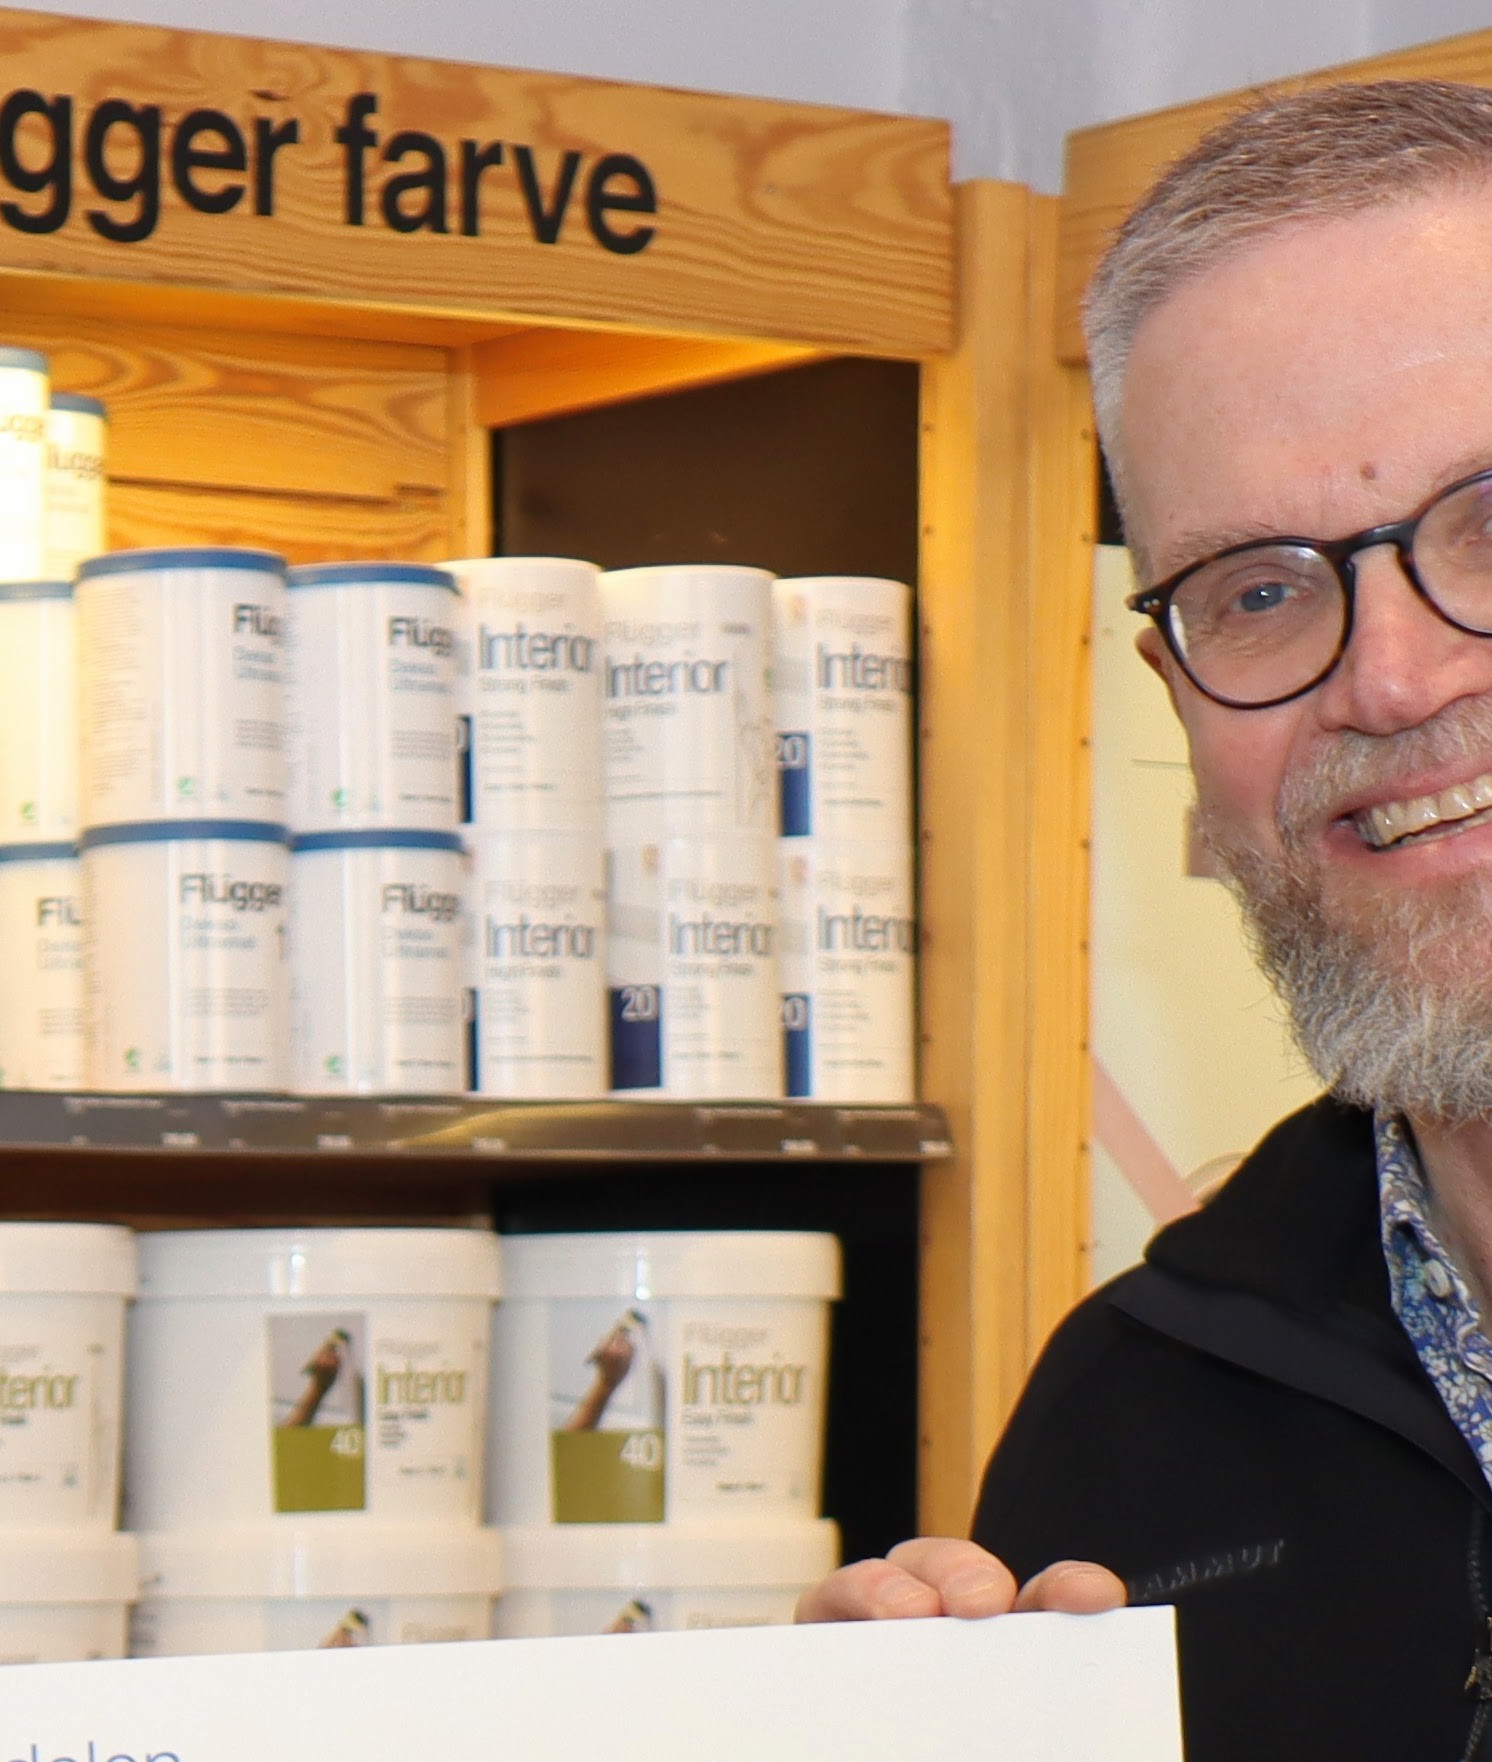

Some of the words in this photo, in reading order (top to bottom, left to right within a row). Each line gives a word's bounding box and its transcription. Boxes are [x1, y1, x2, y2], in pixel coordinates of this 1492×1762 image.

[336, 92, 658, 256] farve
[604, 653, 730, 698] Interior
[620, 986, 656, 1022] 20
[684, 1352, 804, 1406] Interior
[329, 1430, 361, 1457] 40
[620, 1435, 661, 1470] 40
